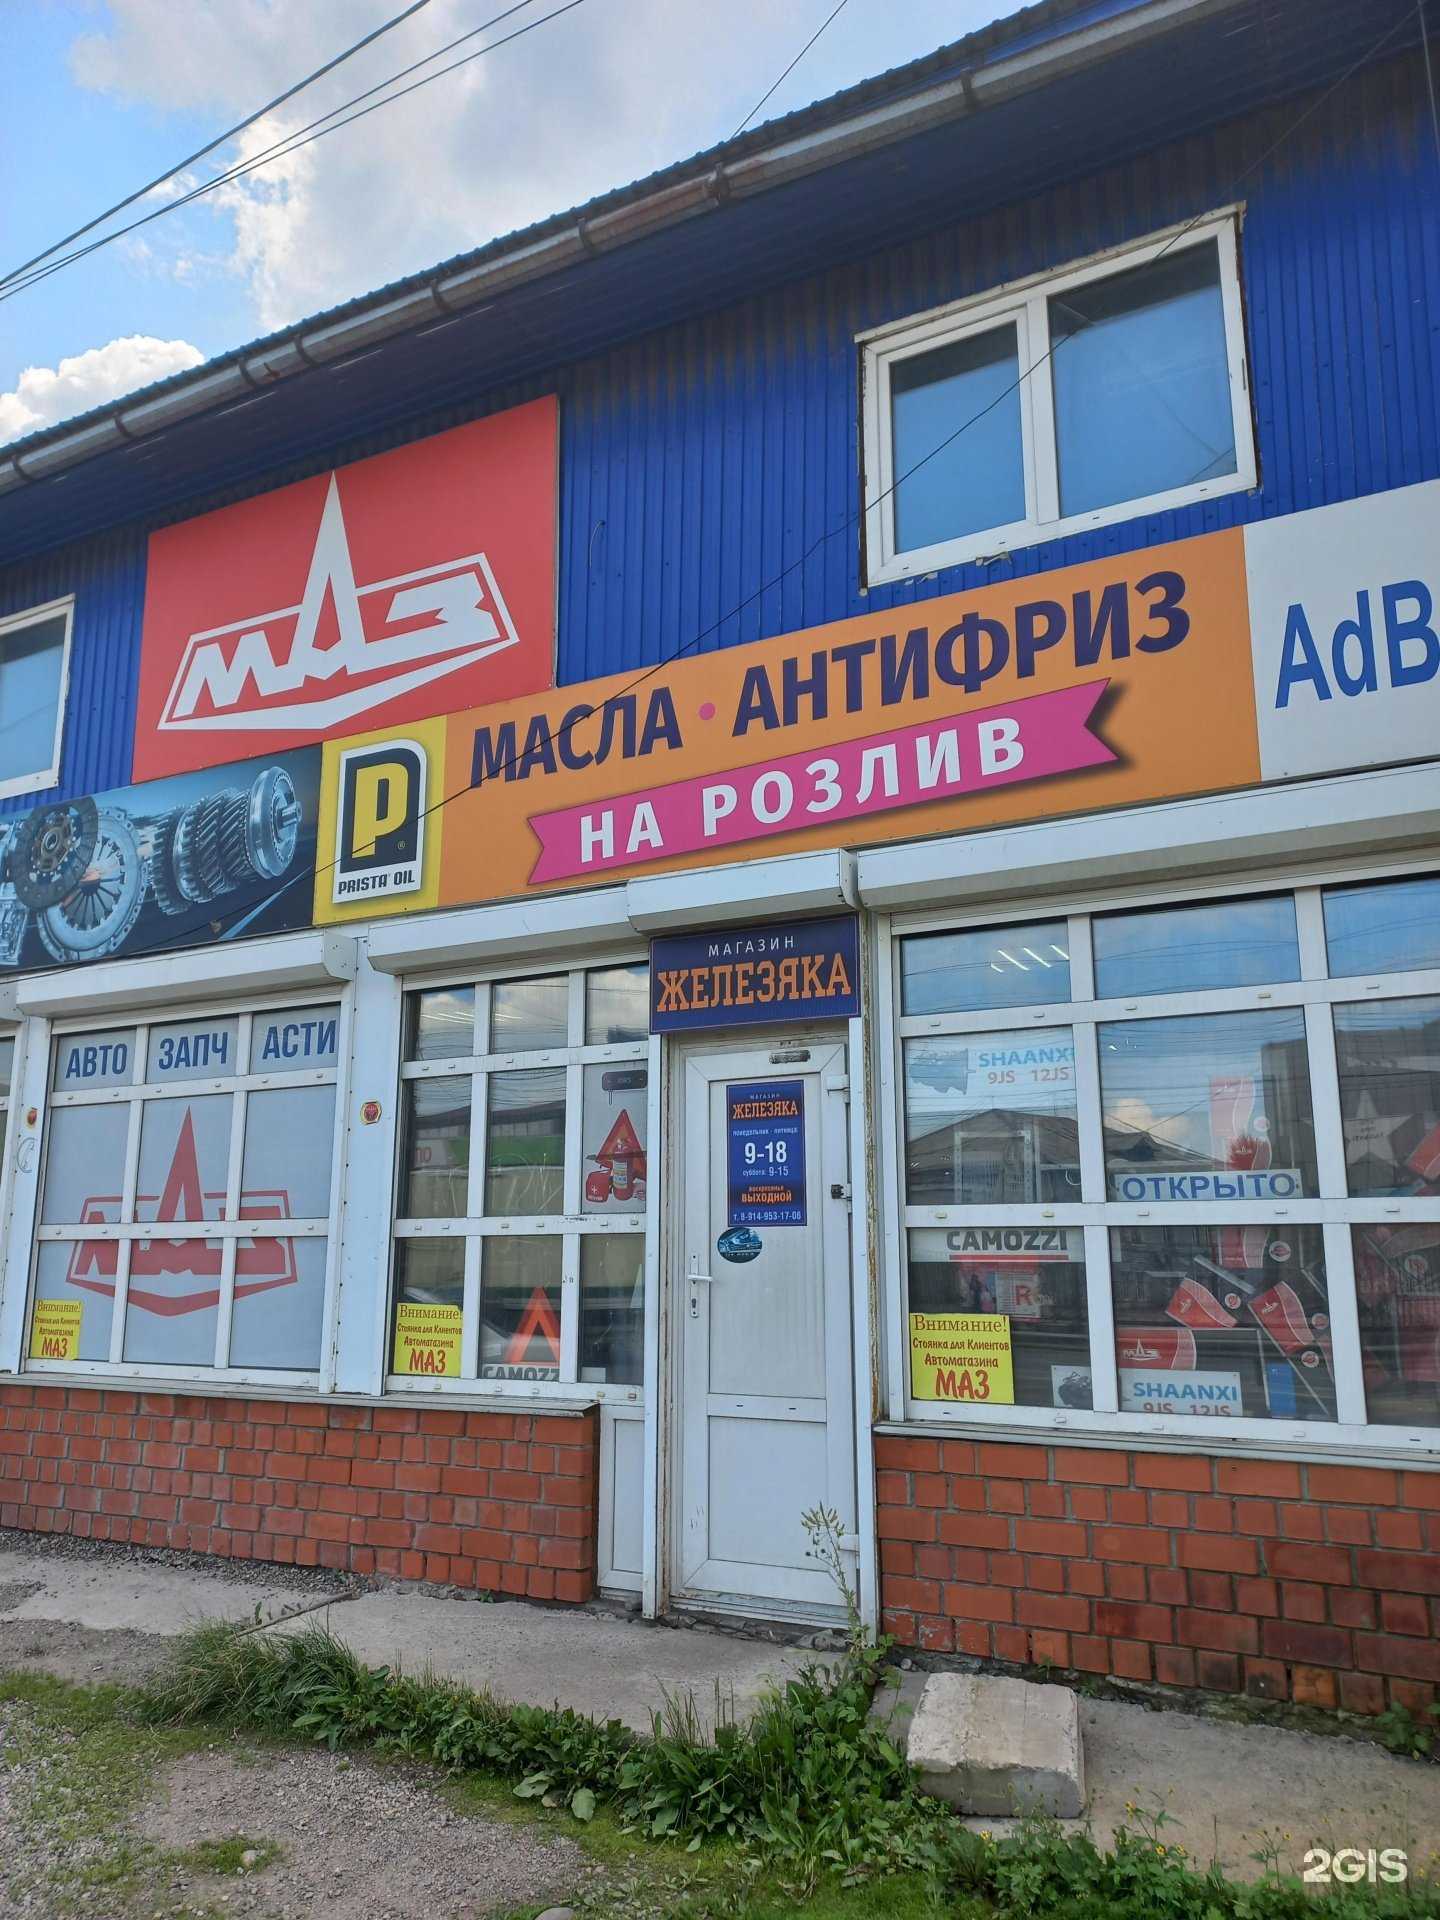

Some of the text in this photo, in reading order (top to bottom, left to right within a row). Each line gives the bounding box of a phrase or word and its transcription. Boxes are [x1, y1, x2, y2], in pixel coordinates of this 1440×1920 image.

[1275, 579, 1440, 709] AdB
[470, 571, 1190, 788] МАСЛА АНТИФРИЗ
[580, 717, 1024, 863] НА РОЗЛИВ
[338, 869, 416, 895] PRISTA OIL
[708, 935, 795, 958] МАГАЗИН
[656, 952, 852, 1013] ЖЕЛЕЗЯКА
[65, 1020, 337, 1079] АВТО ЗАПЧ АСТИ
[987, 1066, 1073, 1085] 9JS 12JS
[732, 1100, 799, 1120] ЖЕЛЕЗЯКА
[744, 1140, 788, 1164] 9-18
[768, 1165, 790, 1177] 9-15
[1122, 1173, 1296, 1200] ОТКРЫТО
[946, 1230, 1068, 1251] CAMOZZI
[914, 1315, 1010, 1332] Внимание!
[41, 1336, 68, 1358] МАЗ
[912, 1337, 1009, 1351] Стоянка для Клиентов
[409, 1348, 446, 1374] МАЗ
[924, 1353, 999, 1368] Автомагазина
[483, 1366, 560, 1381] CAMOZZ
[935, 1368, 990, 1400] МАЗ
[1133, 1382, 1238, 1401] SHAANXI
